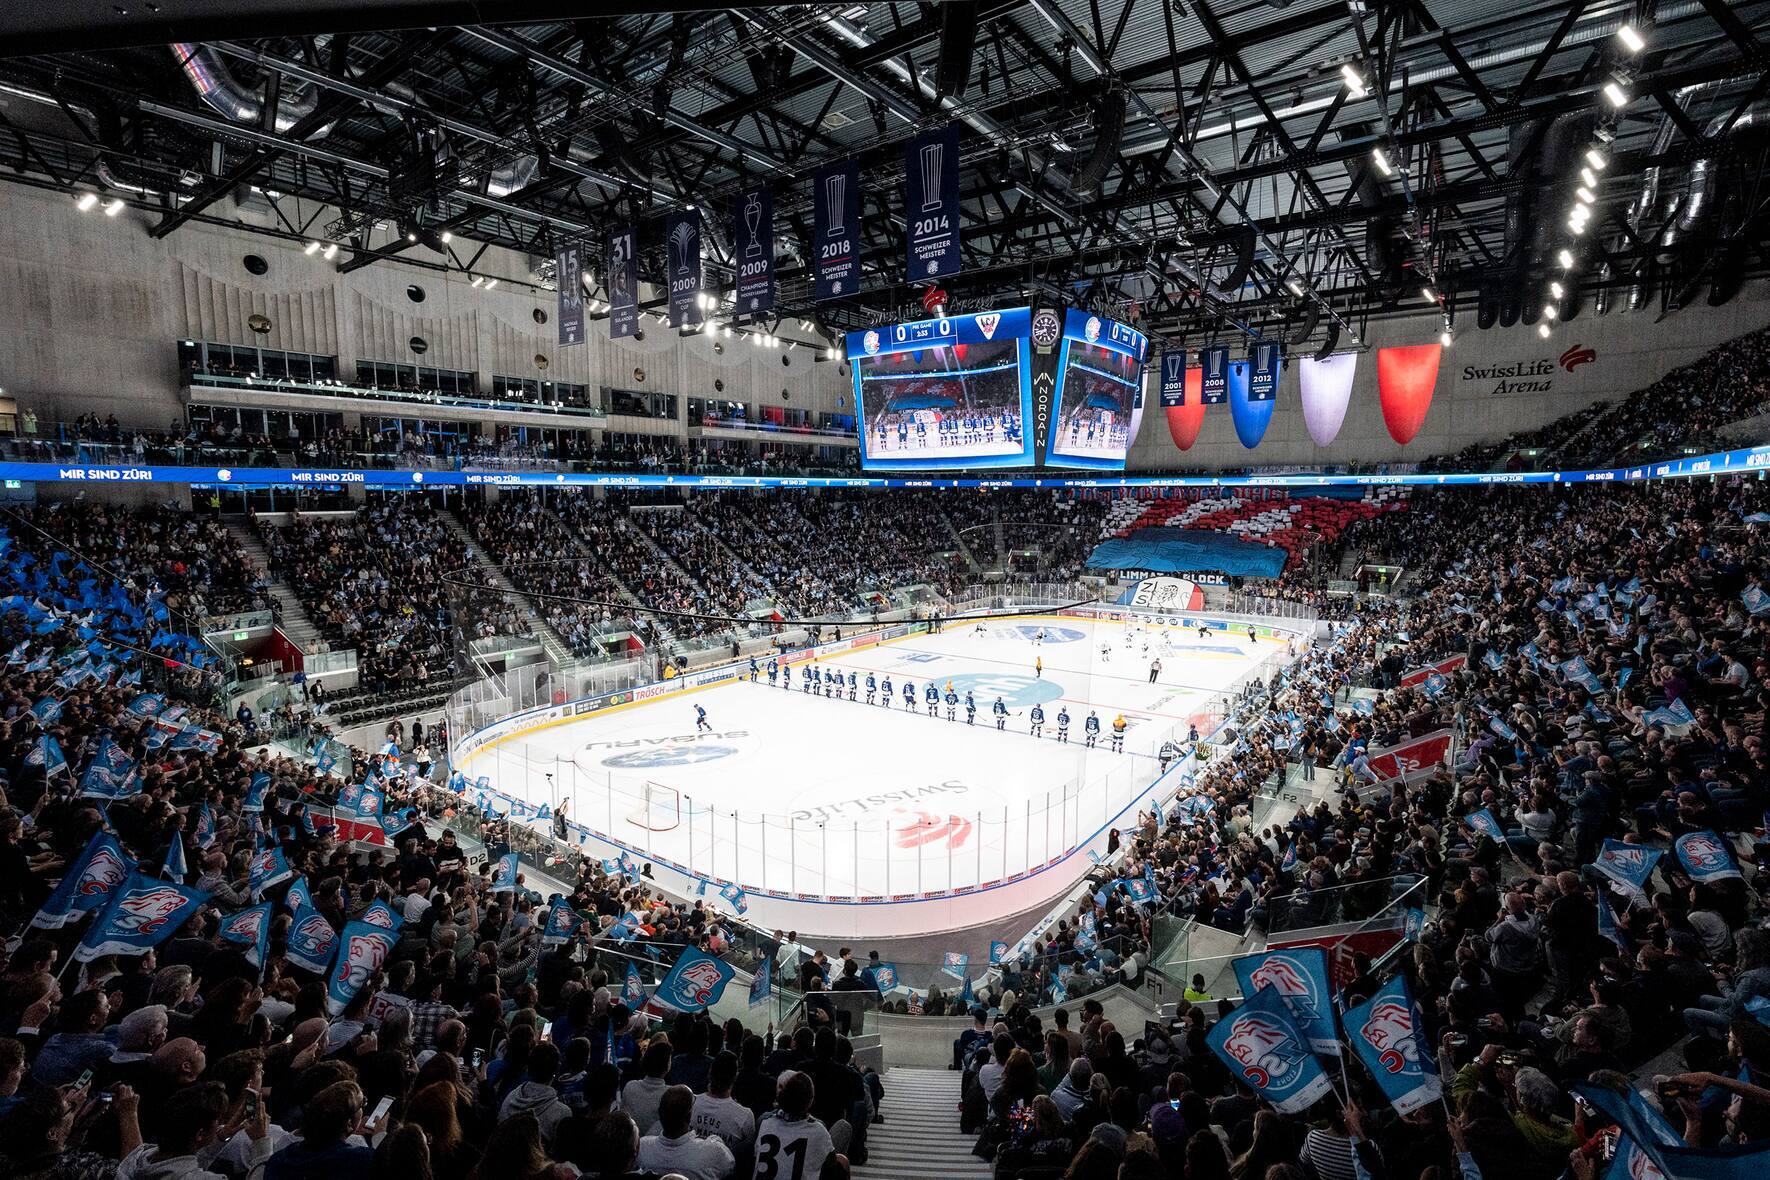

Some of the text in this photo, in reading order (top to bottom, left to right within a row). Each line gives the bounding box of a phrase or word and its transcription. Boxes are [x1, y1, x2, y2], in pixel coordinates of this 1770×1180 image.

[914, 215, 949, 236] 2014
[612, 234, 631, 261] 31
[821, 239, 851, 258] 2018
[914, 240, 951, 253] SCHWEIZER
[919, 249, 946, 260] MEISTER
[560, 249, 578, 276] 15
[740, 260, 768, 277] 2009
[821, 262, 852, 275] SCHWEIZER
[825, 271, 848, 280] MEISTER
[672, 277, 696, 293] 2009
[741, 281, 768, 292] CHAMPIONS
[896, 326, 906, 341] 0
[939, 319, 950, 336] 0
[1462, 358, 1554, 381] SwissLife
[1164, 382, 1182, 390] 2001
[1253, 375, 1272, 383] 2012
[1491, 380, 1552, 394] Arena
[60, 468, 152, 480] MIR SIND ZÜRI
[291, 472, 364, 482] MIR SIND ZÜRI
[466, 474, 521, 483] MIR SIND ZÜRI
[1183, 574, 1225, 585] BLOCK
[635, 685, 666, 700] TRÖSCH
[585, 730, 750, 750] SUBARU
[791, 780, 969, 824] SwissLife
[1283, 793, 1298, 804] F2
[470, 853, 486, 865] D2
[669, 979, 713, 1006] ZSC
[1147, 976, 1163, 995] F1
[697, 1114, 721, 1129] DEUS
[757, 1133, 809, 1180] 31
